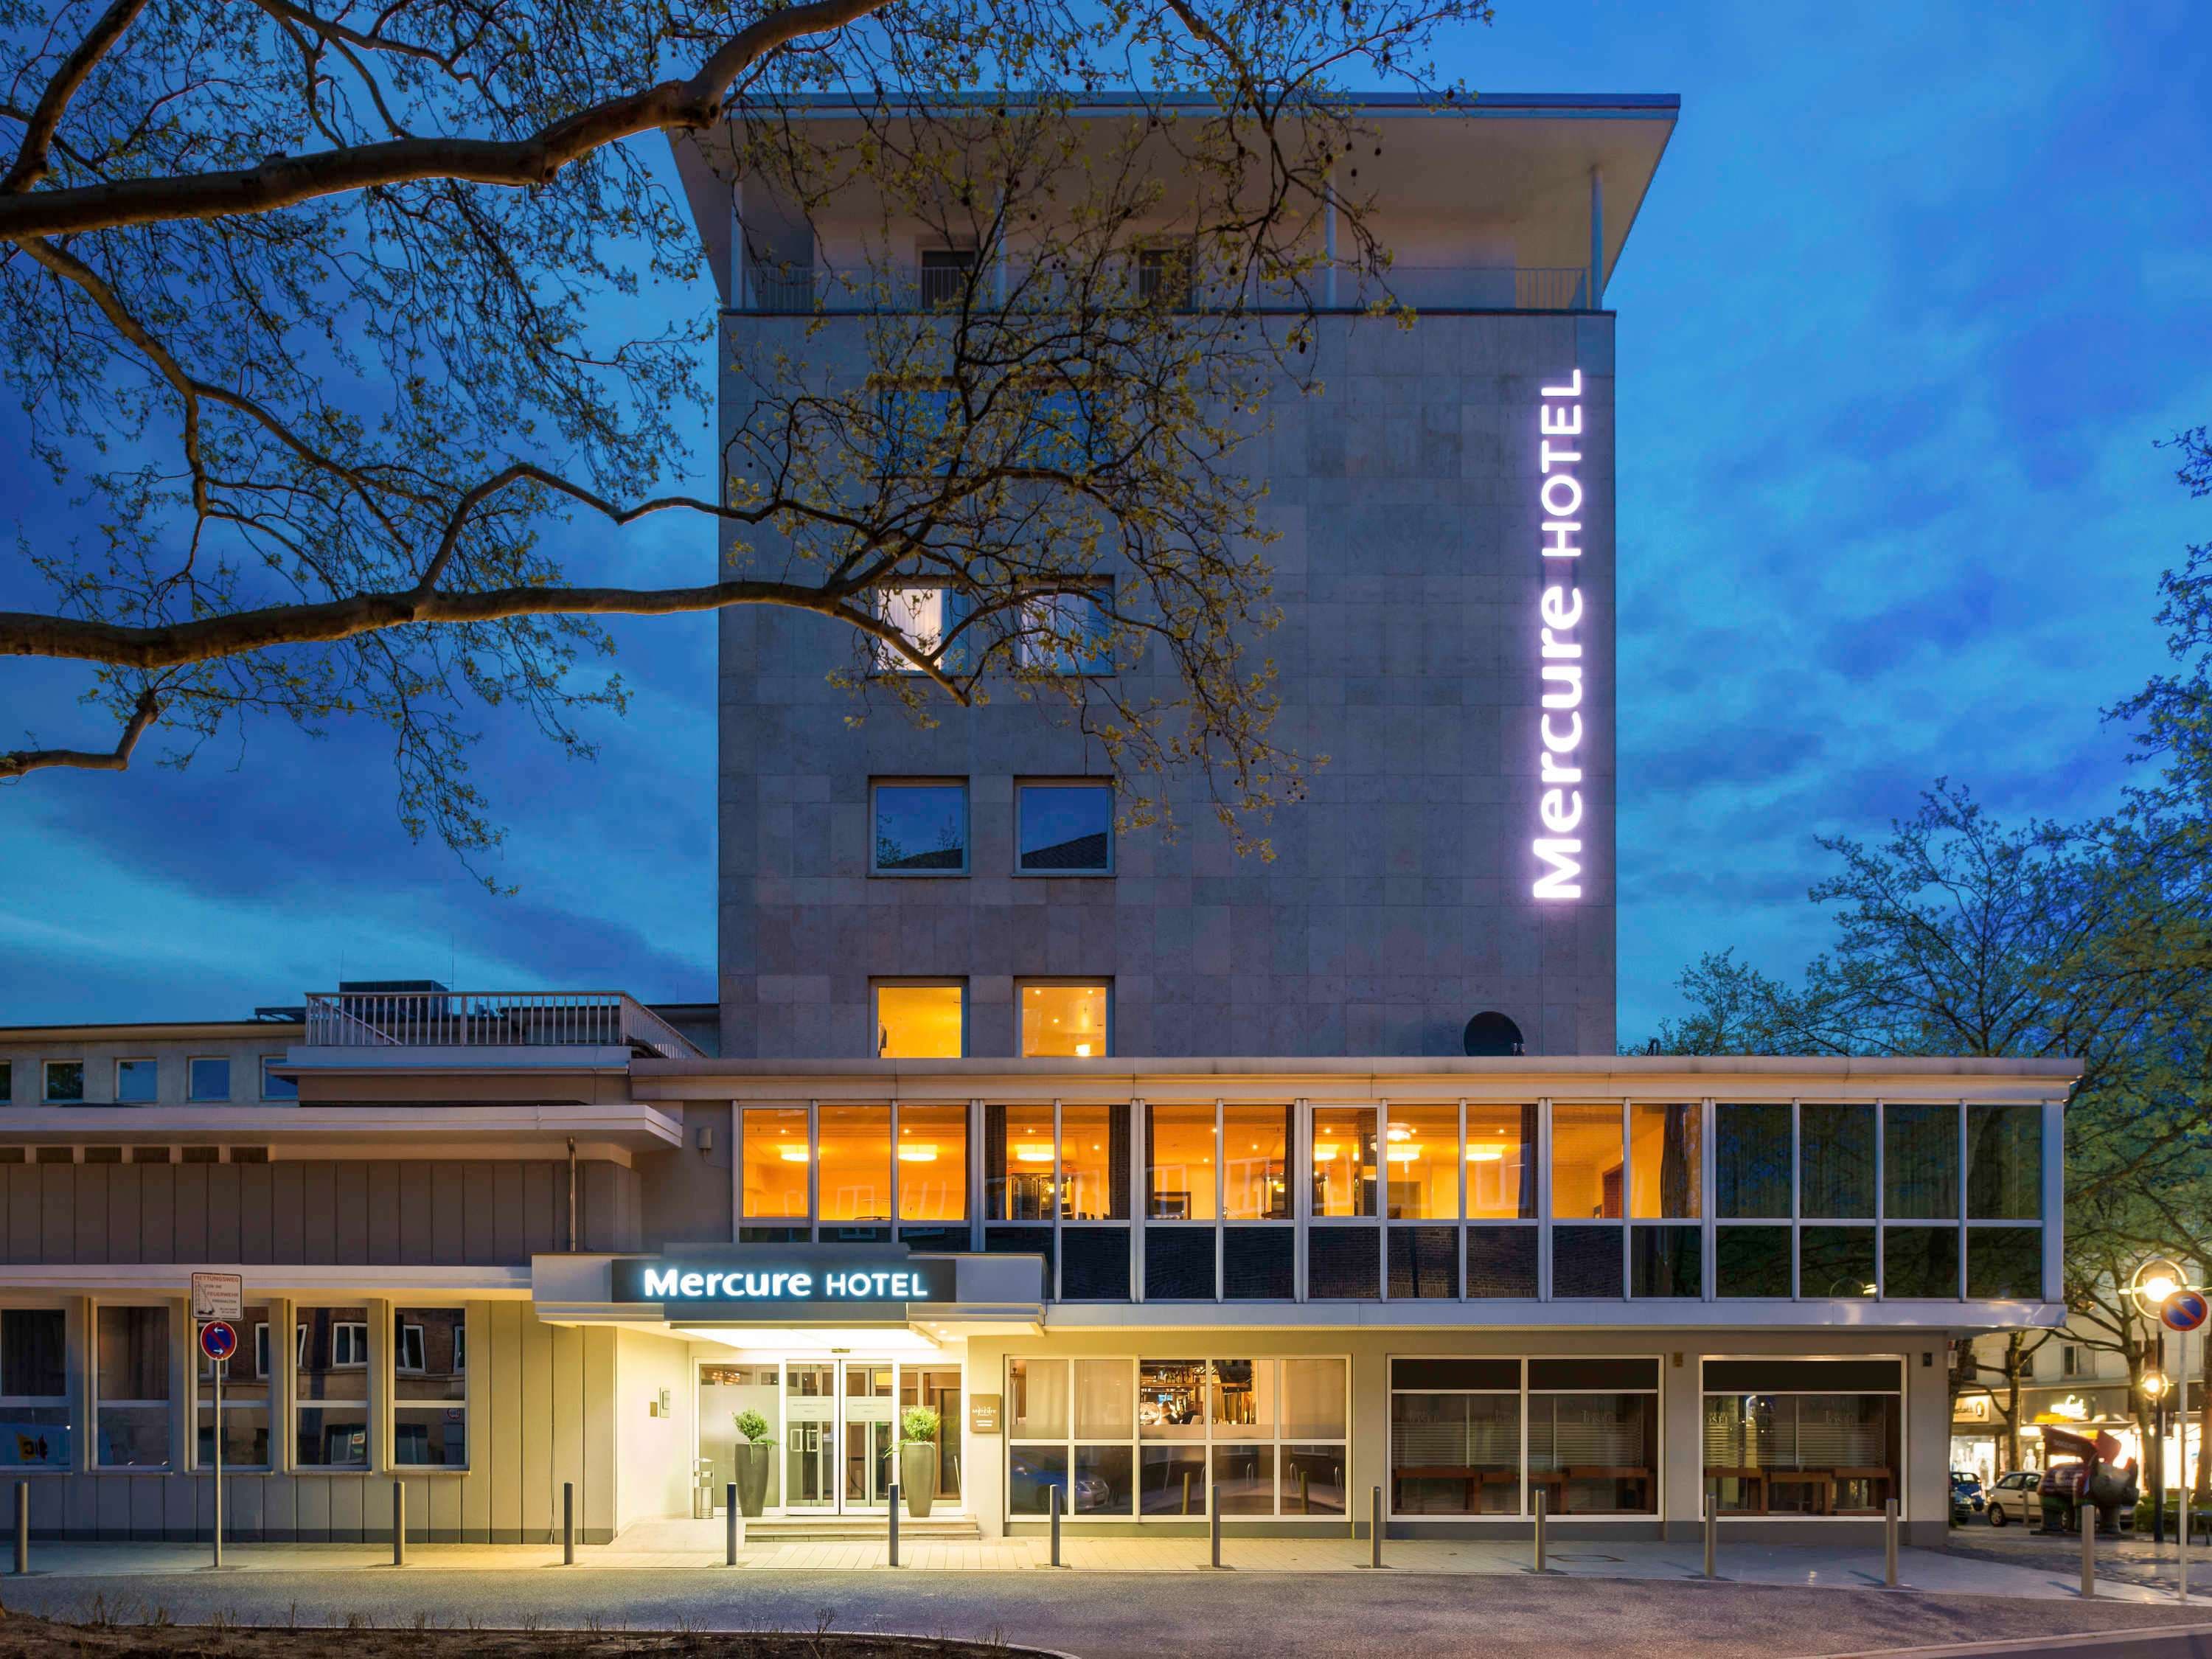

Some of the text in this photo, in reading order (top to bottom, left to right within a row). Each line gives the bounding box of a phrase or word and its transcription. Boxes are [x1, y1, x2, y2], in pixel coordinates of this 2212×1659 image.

[1533, 369, 1582, 899] Mercure HOTEL
[644, 1268, 928, 1296] Mercure HOTEL
